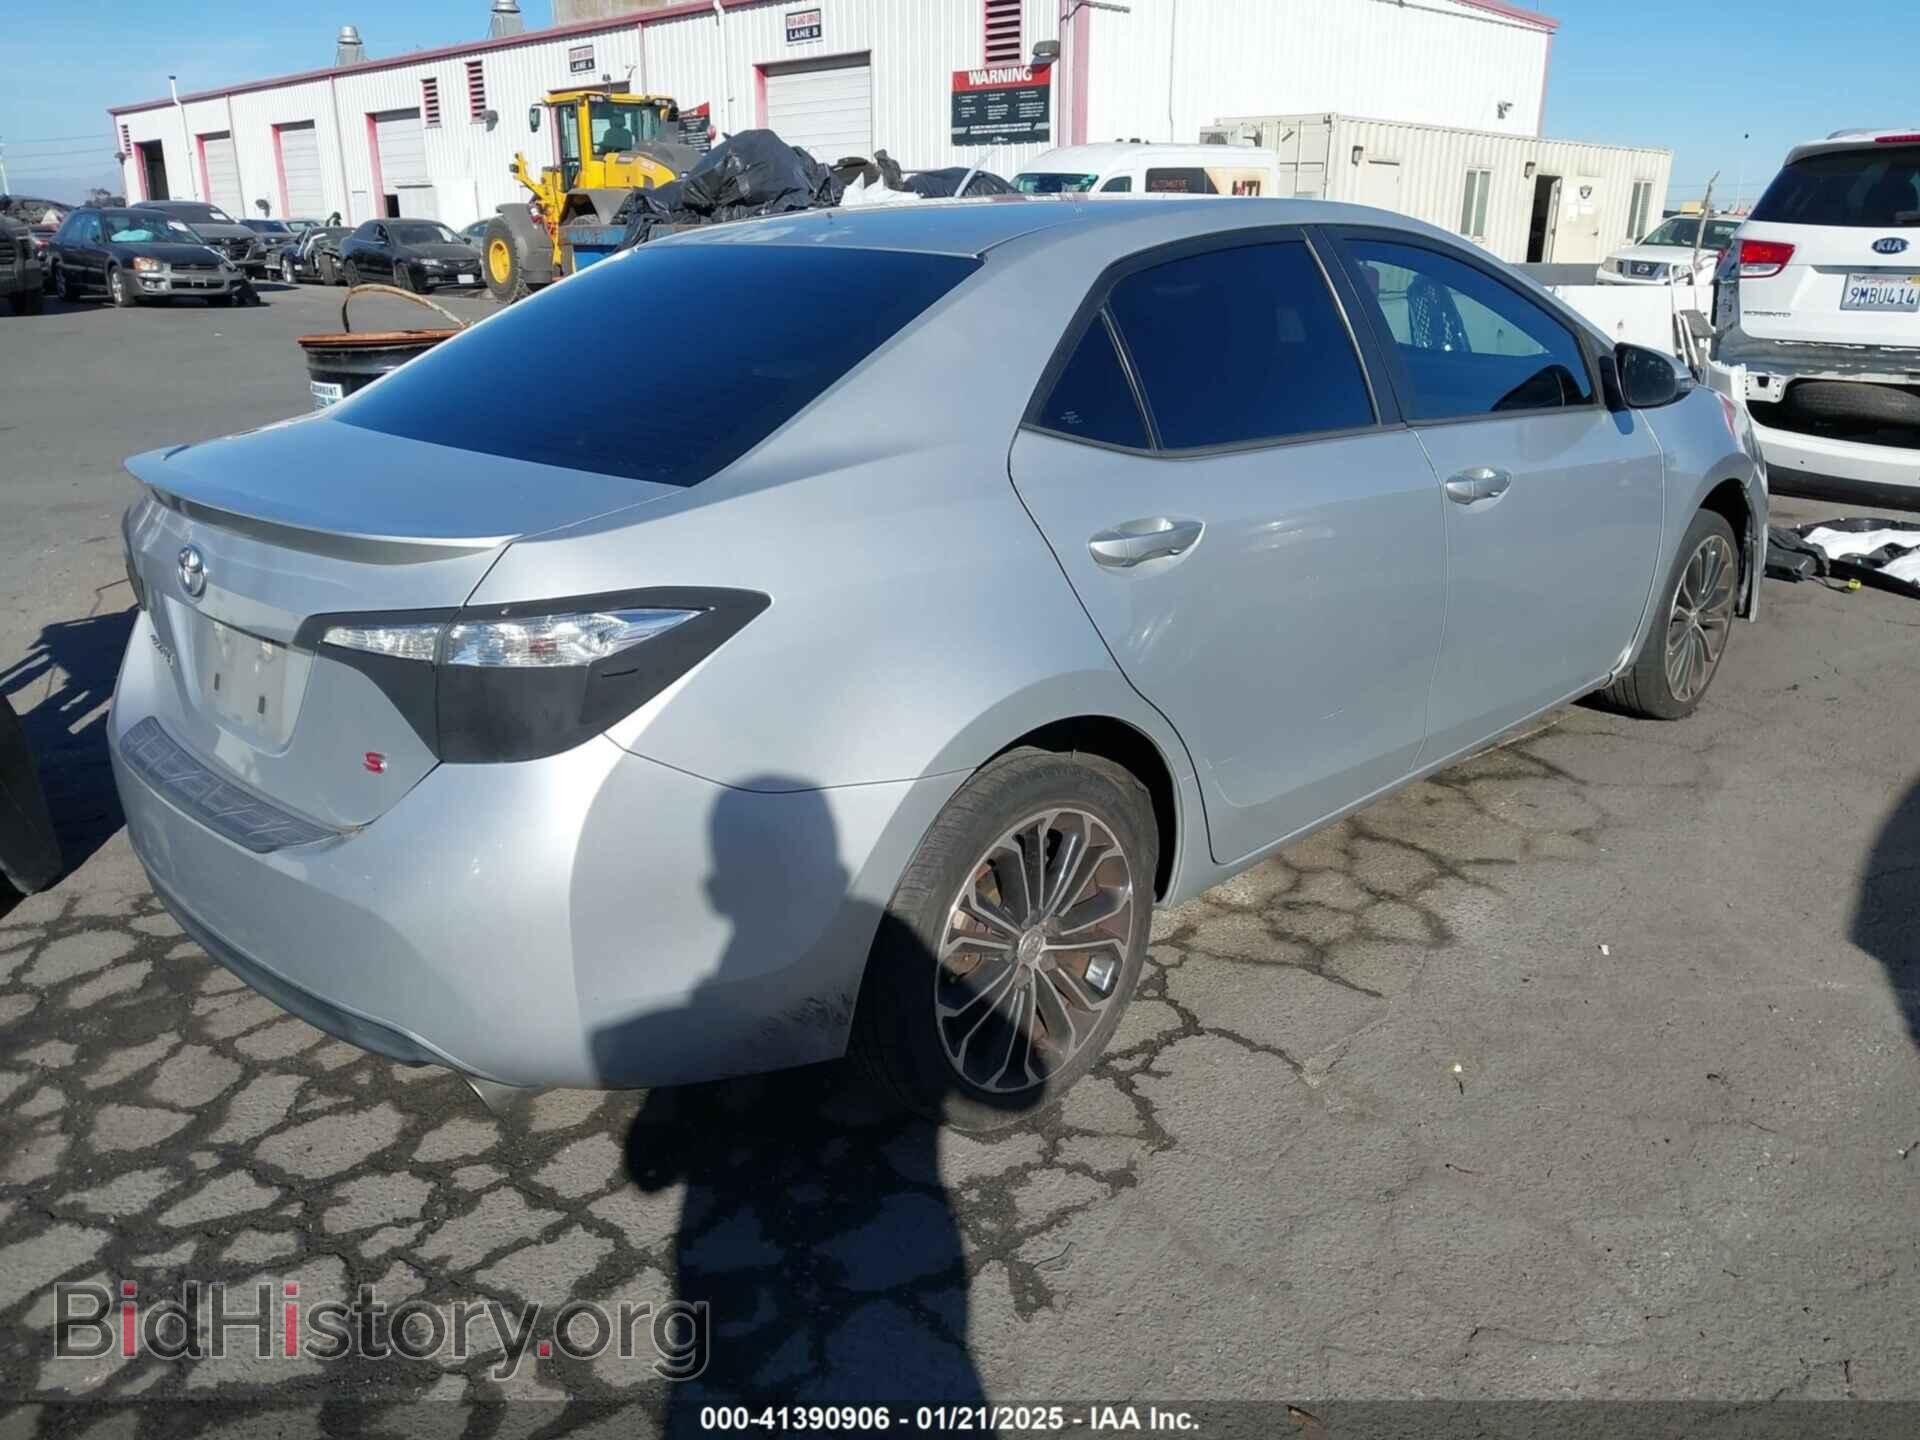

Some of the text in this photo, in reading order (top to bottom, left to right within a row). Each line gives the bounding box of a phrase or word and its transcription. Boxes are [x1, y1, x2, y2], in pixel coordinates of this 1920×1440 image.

[789, 27, 819, 40] LANE B
[968, 67, 1033, 85] WARNING
[1876, 239, 1903, 251] KIA
[1849, 286, 1916, 304] 9MBU414
[362, 751, 388, 774] S
